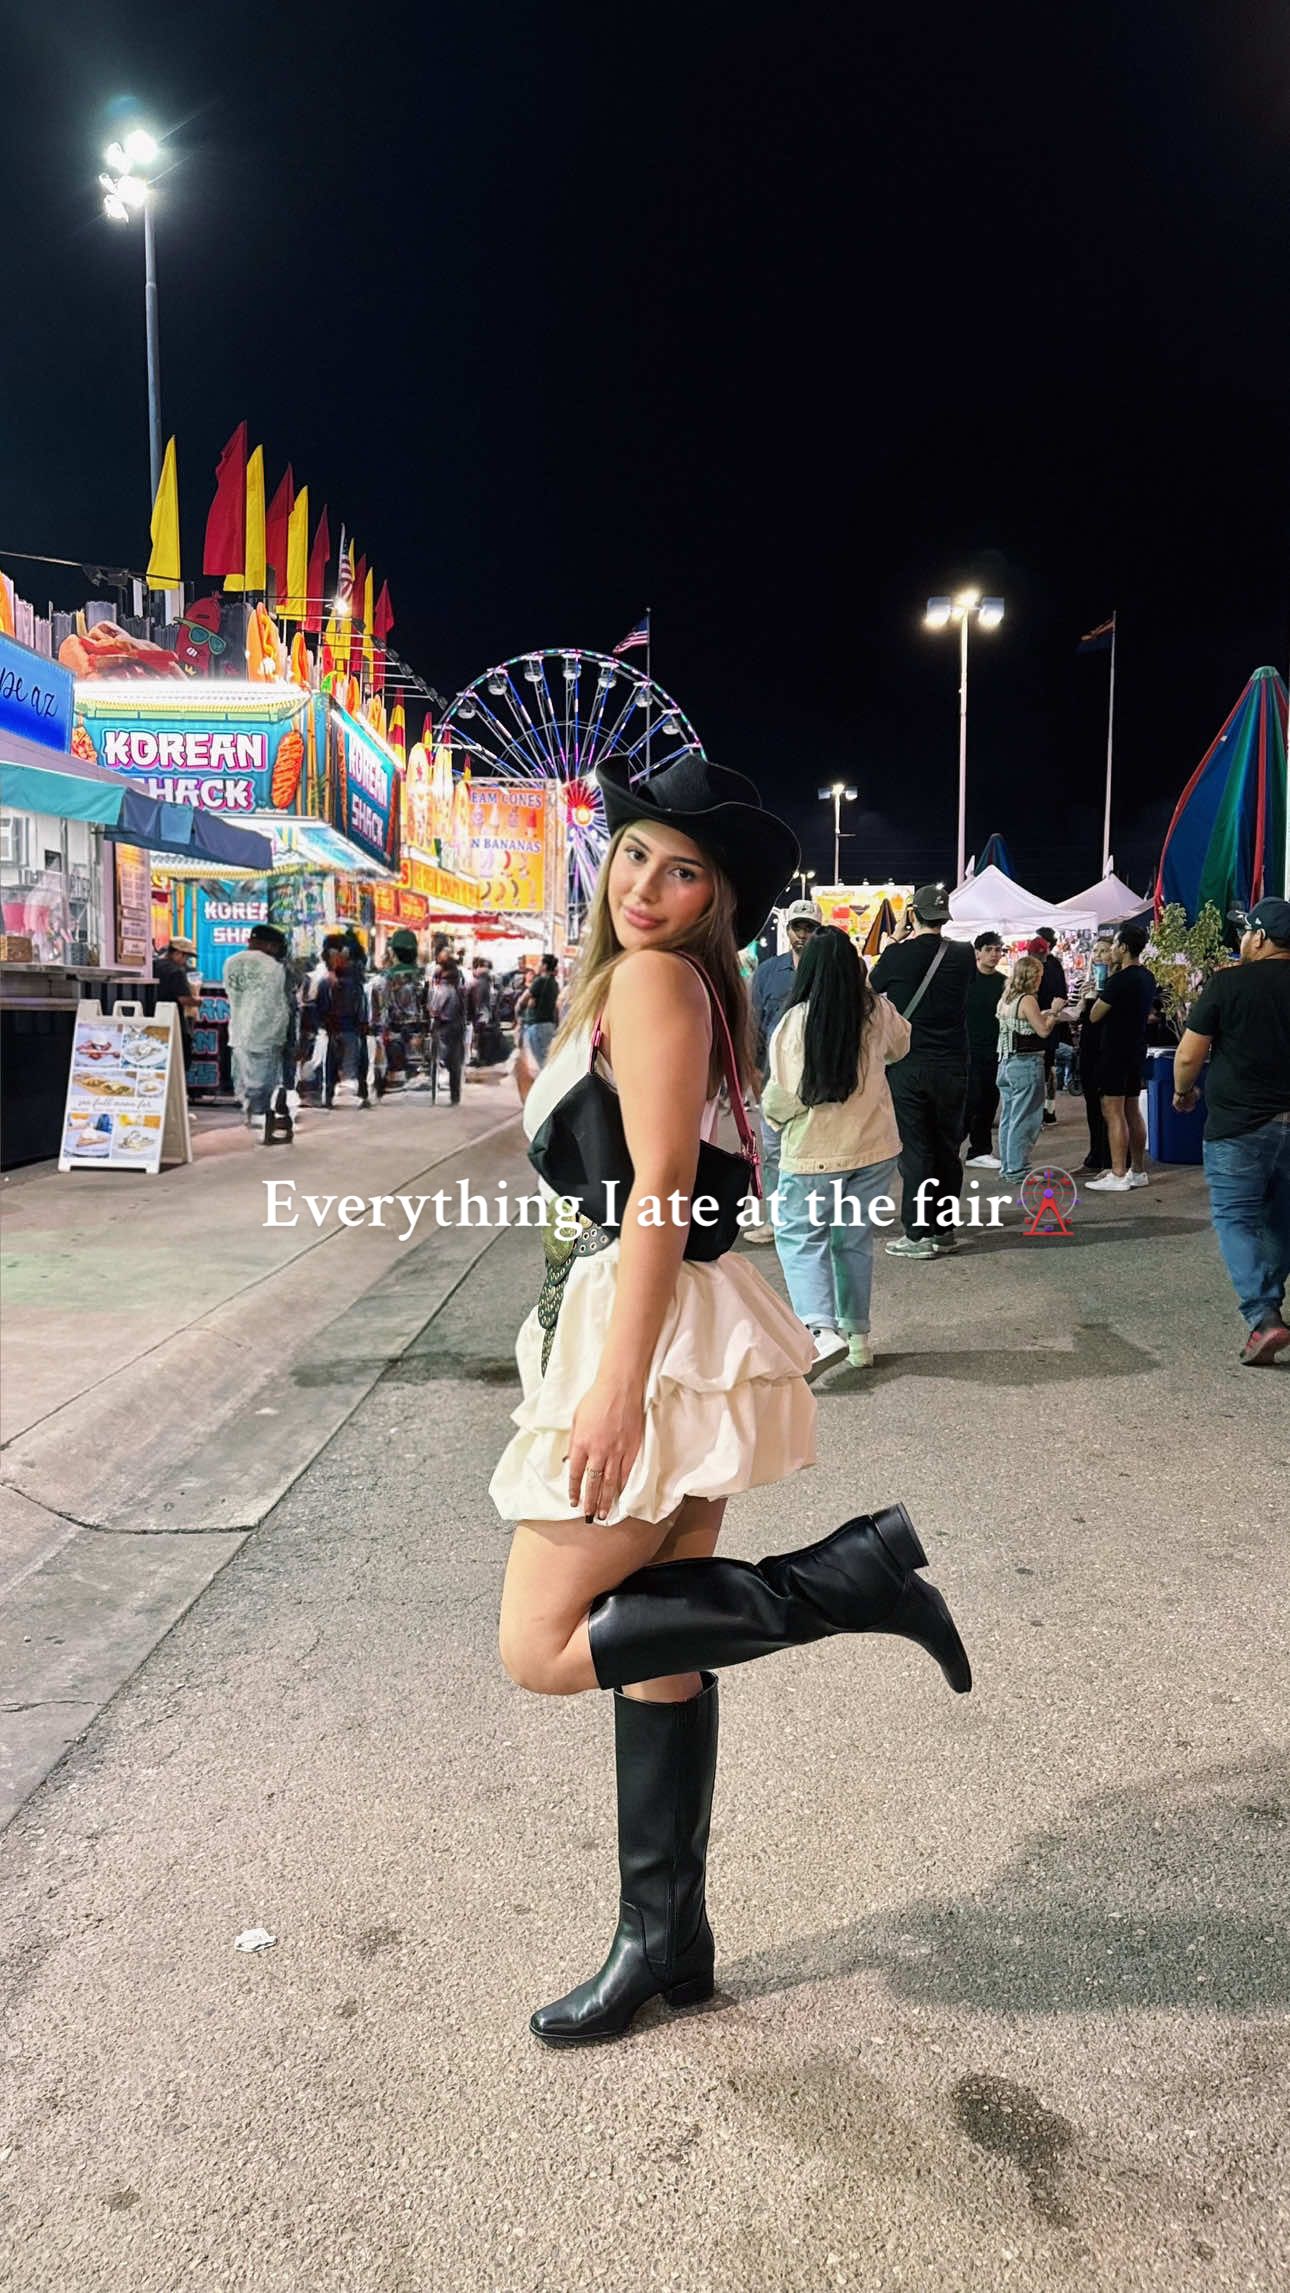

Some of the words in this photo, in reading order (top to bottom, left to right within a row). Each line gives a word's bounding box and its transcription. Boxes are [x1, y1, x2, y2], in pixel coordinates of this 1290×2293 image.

[103, 730, 268, 770] KOREAN
[348, 731, 388, 809] KOREAN
[131, 777, 252, 811] HACK
[502, 793, 543, 809] CONES
[351, 792, 384, 849] SHACK
[484, 838, 542, 854] BANANAS
